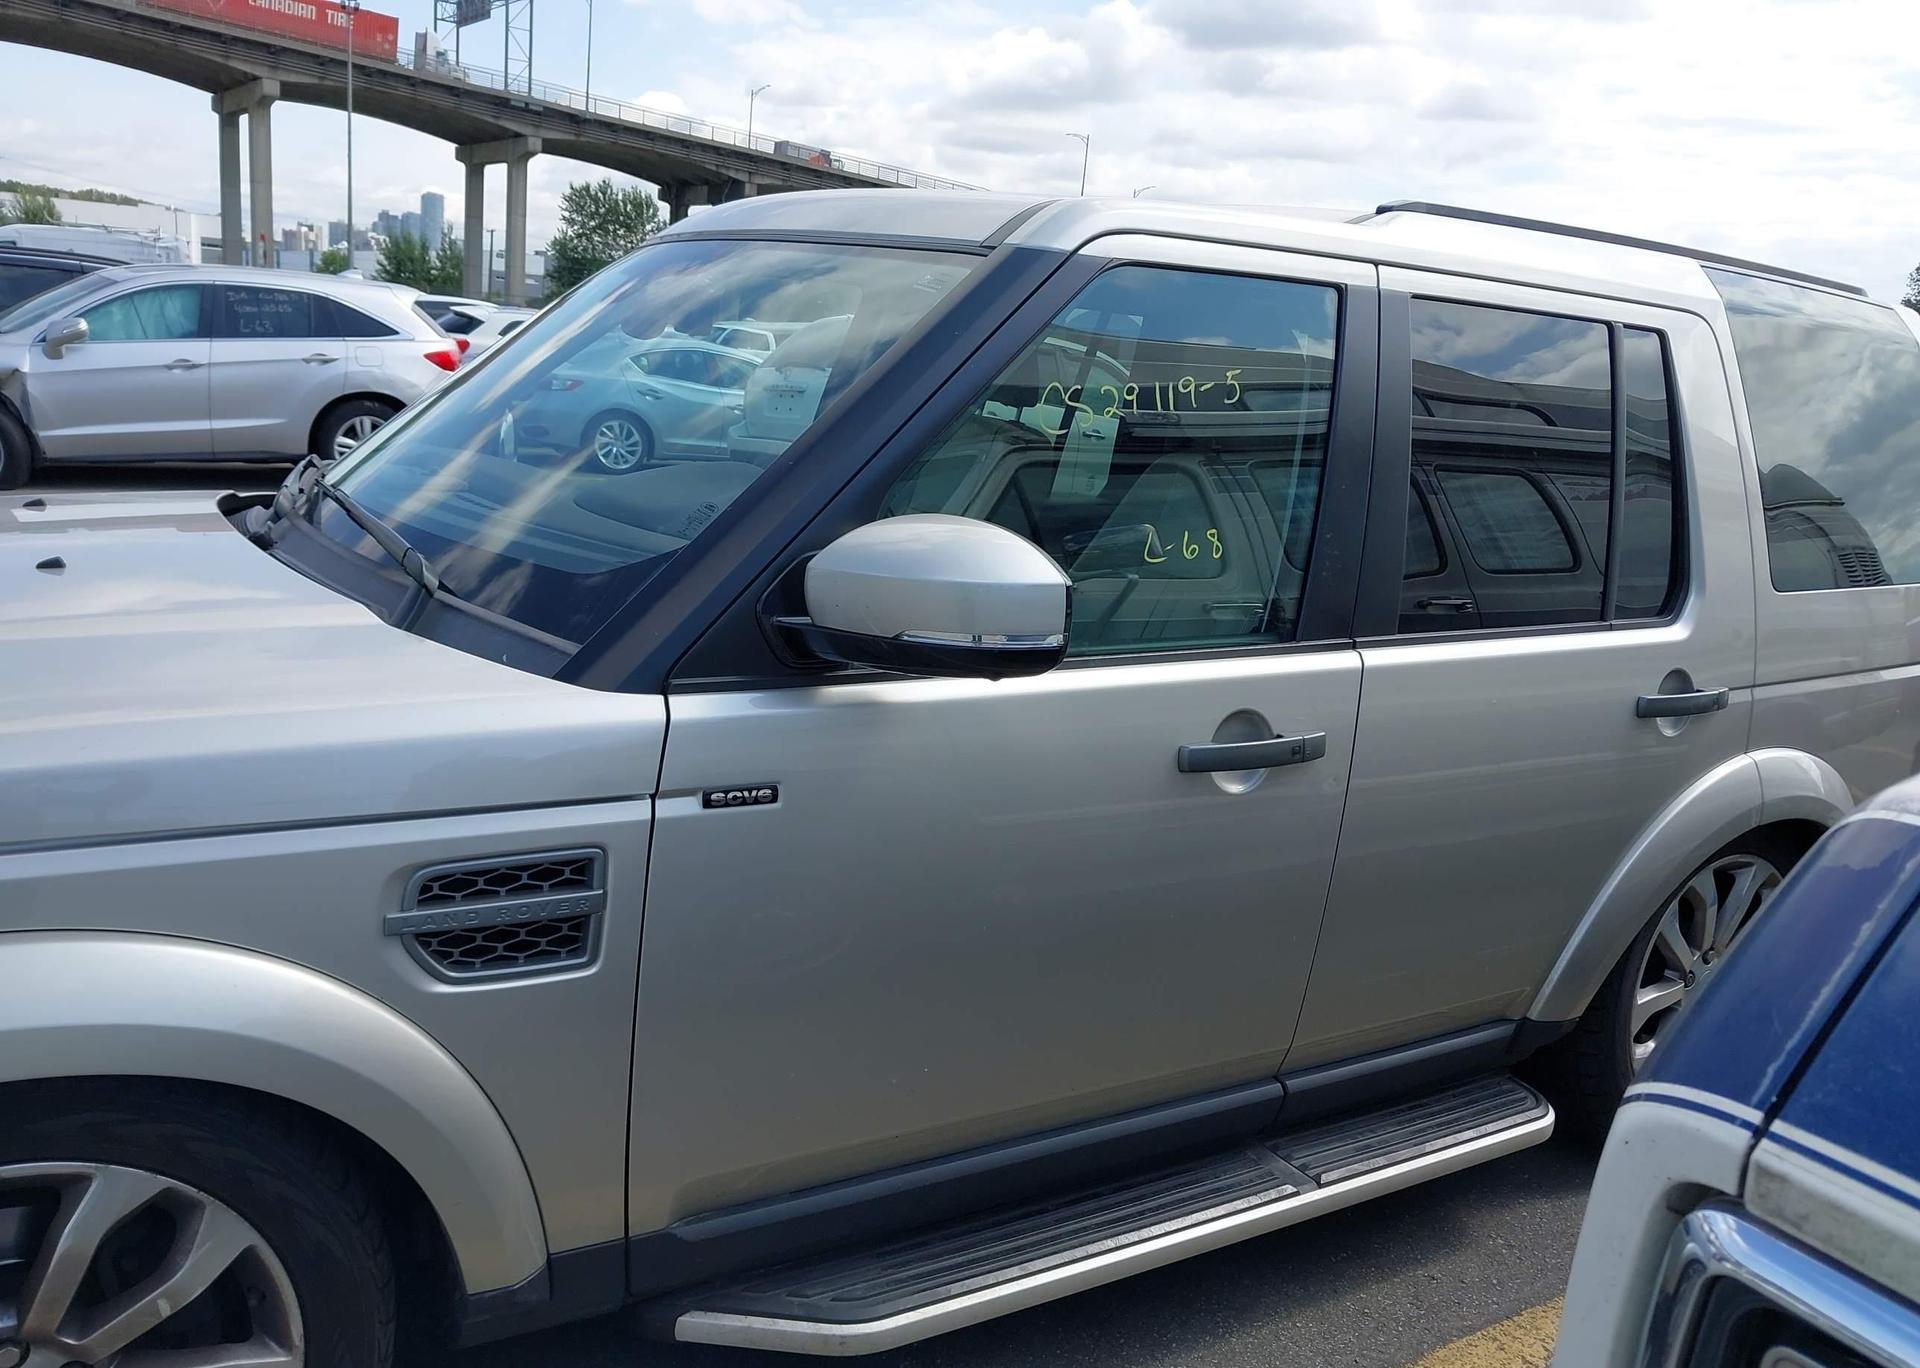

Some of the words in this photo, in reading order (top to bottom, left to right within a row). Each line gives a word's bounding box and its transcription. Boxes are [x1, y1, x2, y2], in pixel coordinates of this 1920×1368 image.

[710, 788, 773, 806] SCV6
[401, 911, 480, 931] LAND
[496, 898, 590, 922] ROVER
